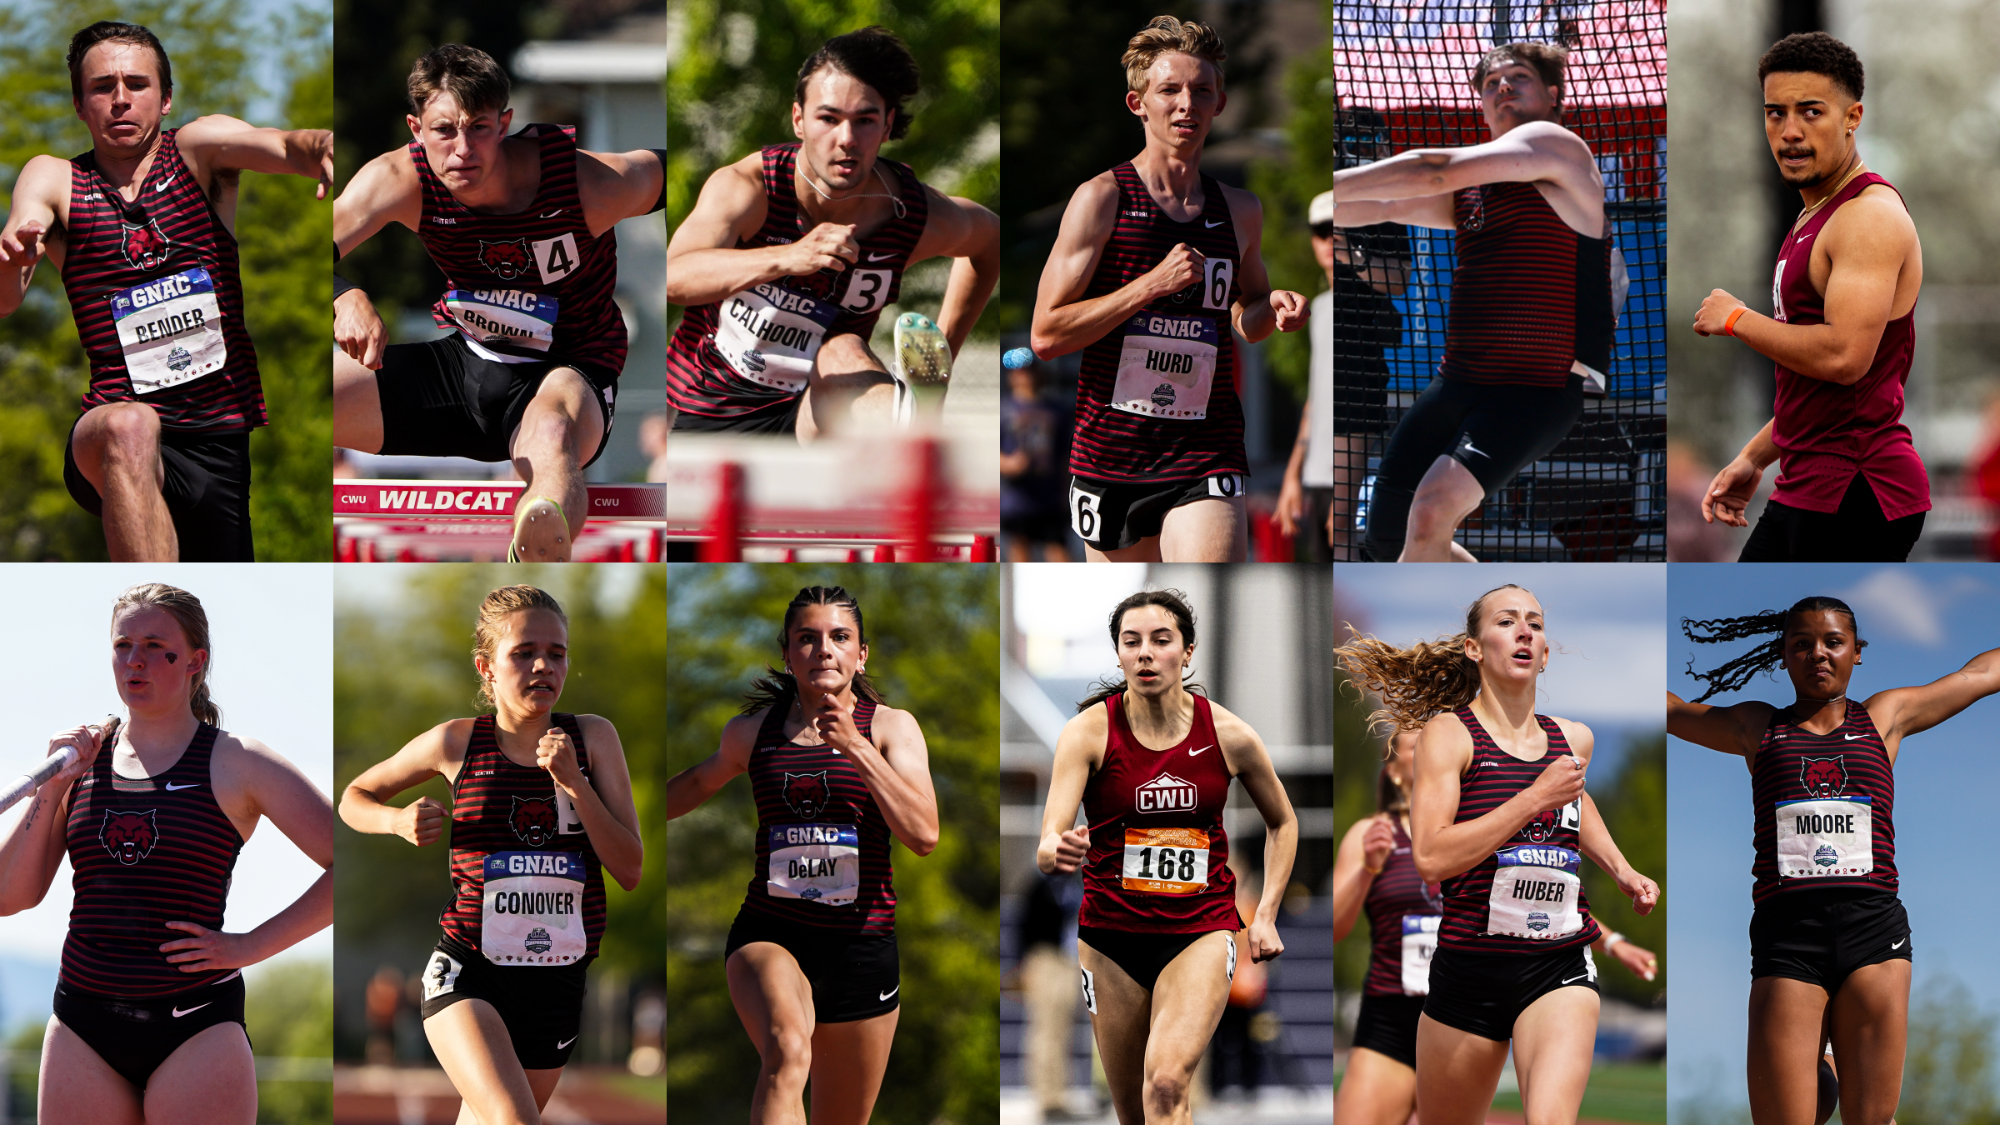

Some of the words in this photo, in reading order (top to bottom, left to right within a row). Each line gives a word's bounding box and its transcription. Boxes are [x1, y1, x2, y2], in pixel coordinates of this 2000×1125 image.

[546, 240, 574, 275] 4
[131, 275, 191, 309] GNAC
[851, 273, 882, 312] 3
[1211, 261, 1227, 307] 6
[473, 289, 538, 312] GNAC
[754, 284, 816, 316] GNAC
[134, 308, 206, 345] BENDER
[463, 309, 534, 339] BROWN
[729, 298, 813, 353] CALHOUN
[1148, 317, 1203, 338] GNAC
[1145, 350, 1194, 374] HURD
[341, 494, 367, 504] CWU
[379, 490, 513, 511] WILDCAT
[594, 497, 620, 507] CWU
[1078, 495, 1095, 538] 6
[1140, 788, 1195, 811] CWU
[786, 827, 839, 845] GNAC
[1796, 814, 1855, 835] MOORE
[508, 855, 569, 875] GNAC
[788, 858, 838, 879] DeLAY
[1138, 847, 1196, 882] 168
[1517, 848, 1569, 868] GNAC
[494, 891, 574, 915] CONOVER
[1512, 879, 1566, 903] HUBER
